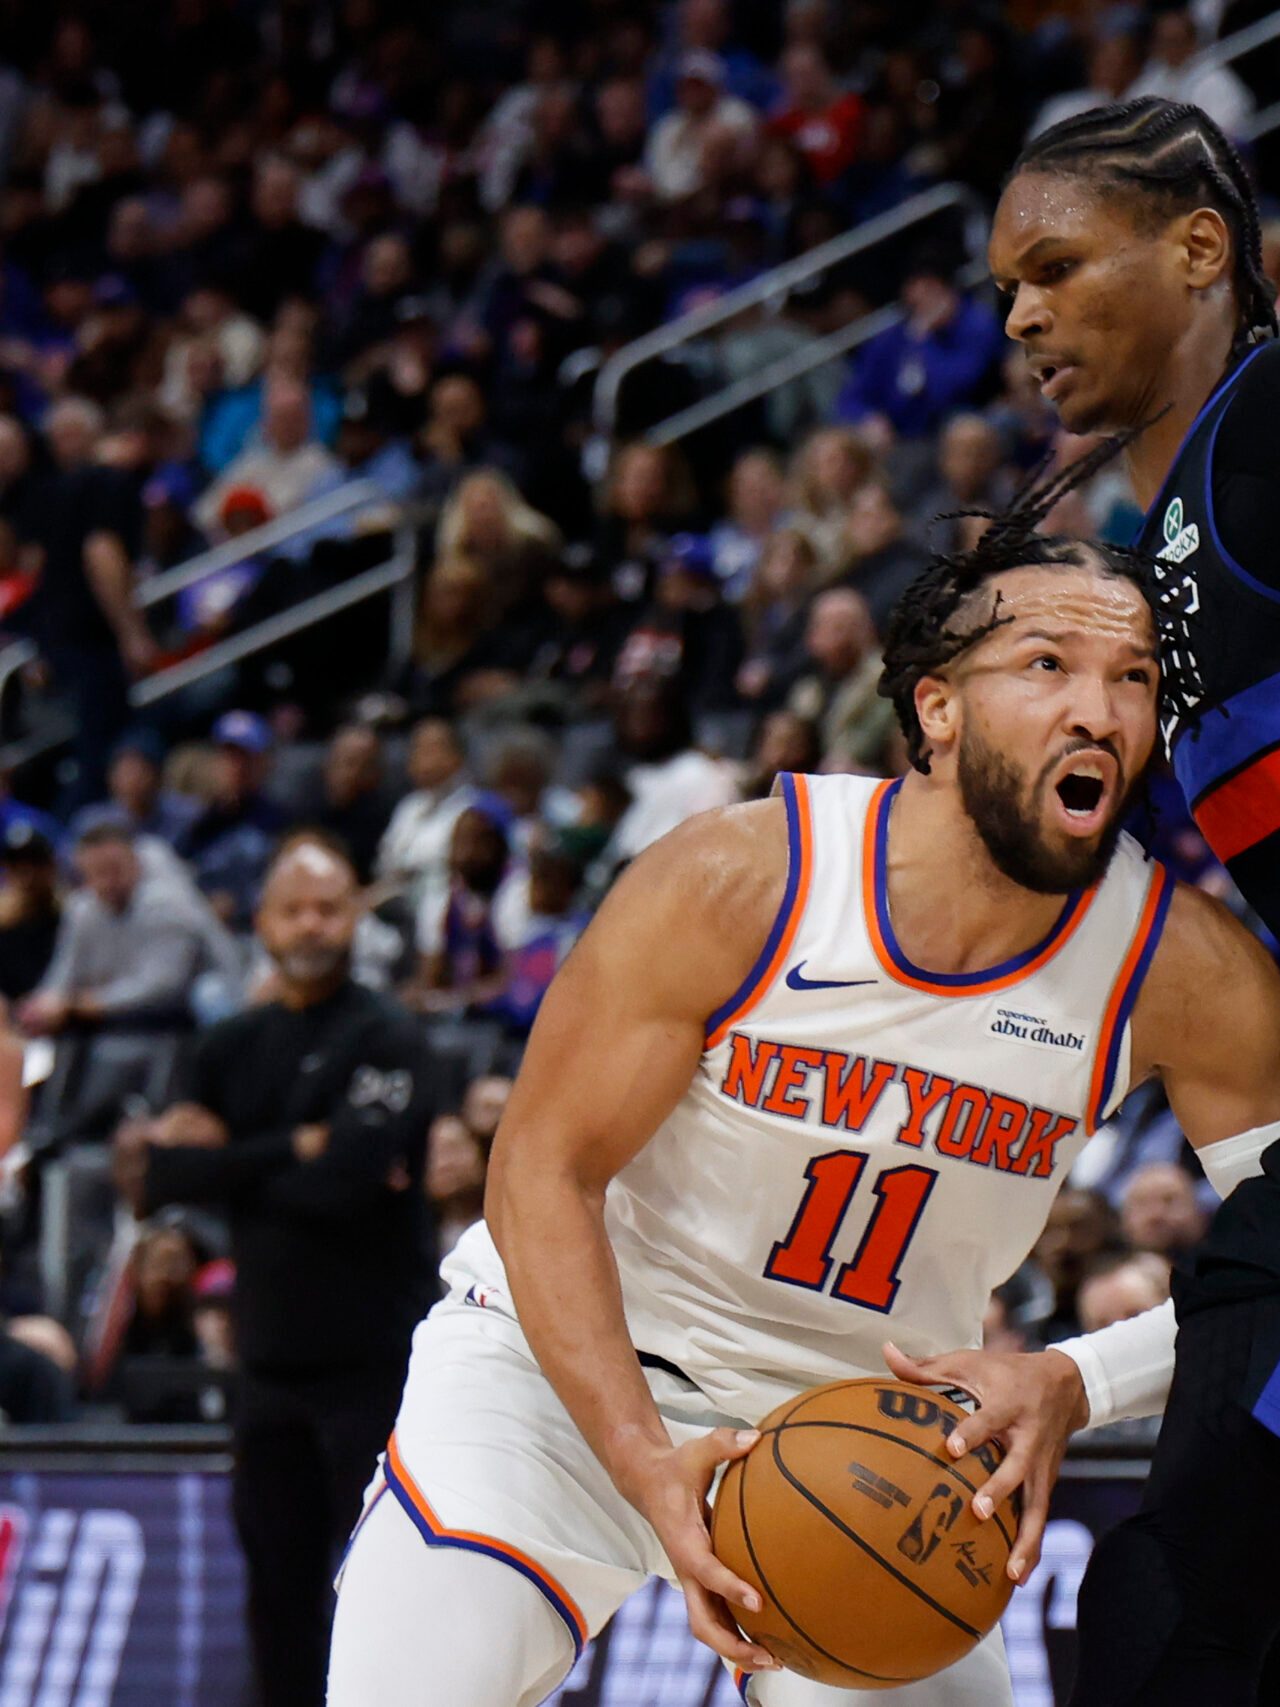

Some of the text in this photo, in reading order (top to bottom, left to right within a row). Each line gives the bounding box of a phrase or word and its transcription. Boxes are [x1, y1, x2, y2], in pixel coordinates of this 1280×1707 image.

[990, 1019, 1086, 1050] abu dhabi
[996, 1008, 1048, 1026] experience
[721, 1033, 1080, 1179] NEW YORK
[763, 1149, 940, 1315] 11
